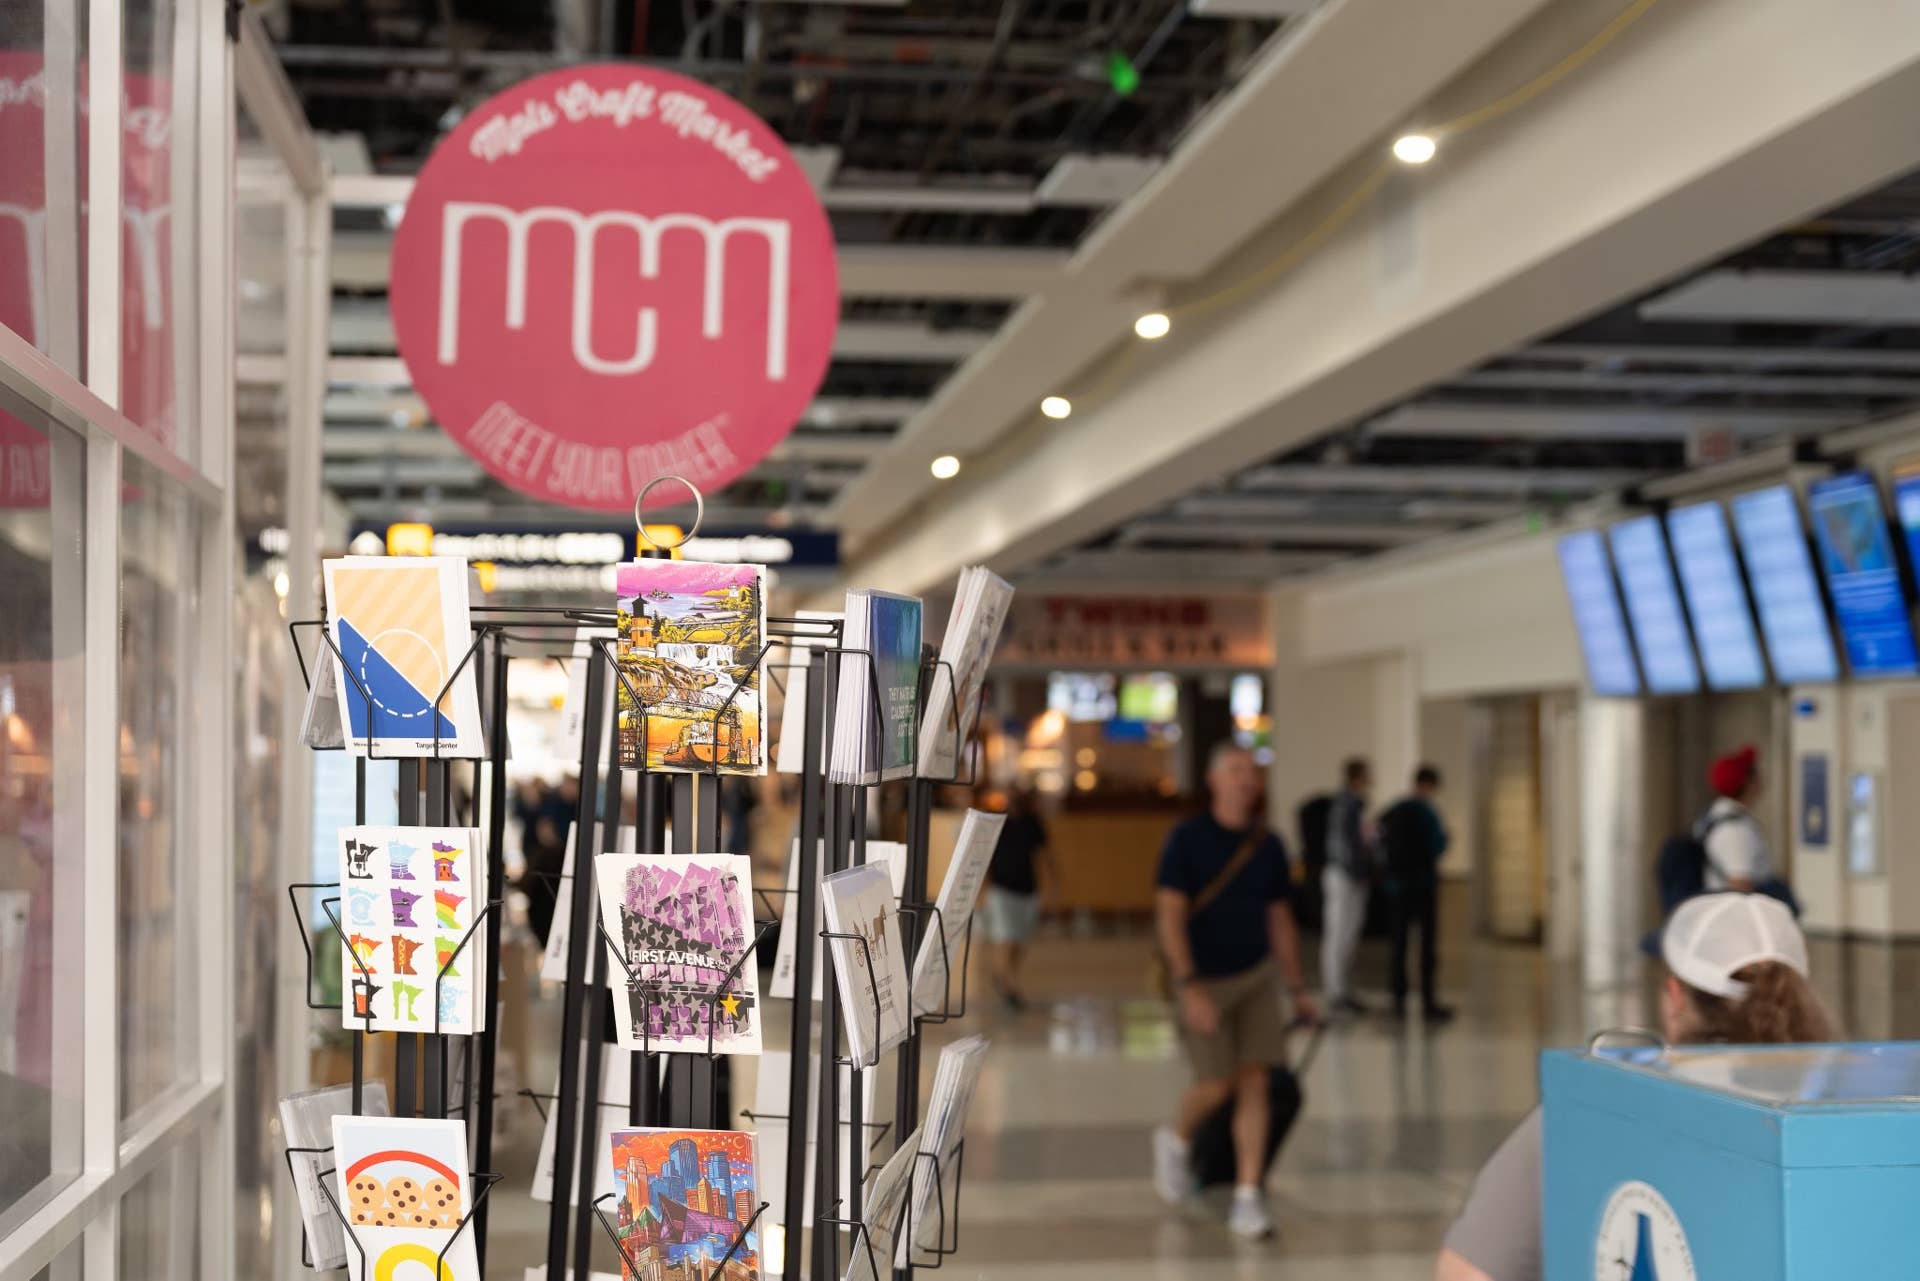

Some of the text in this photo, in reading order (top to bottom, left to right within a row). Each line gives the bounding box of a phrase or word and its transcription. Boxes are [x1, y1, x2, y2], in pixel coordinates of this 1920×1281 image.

[556, 80, 656, 127] Craft
[659, 91, 779, 182] Market
[465, 400, 556, 483] MEET
[546, 438, 625, 501] YOUR
[631, 950, 665, 963] FIRST
[667, 951, 715, 969] AVENUE
